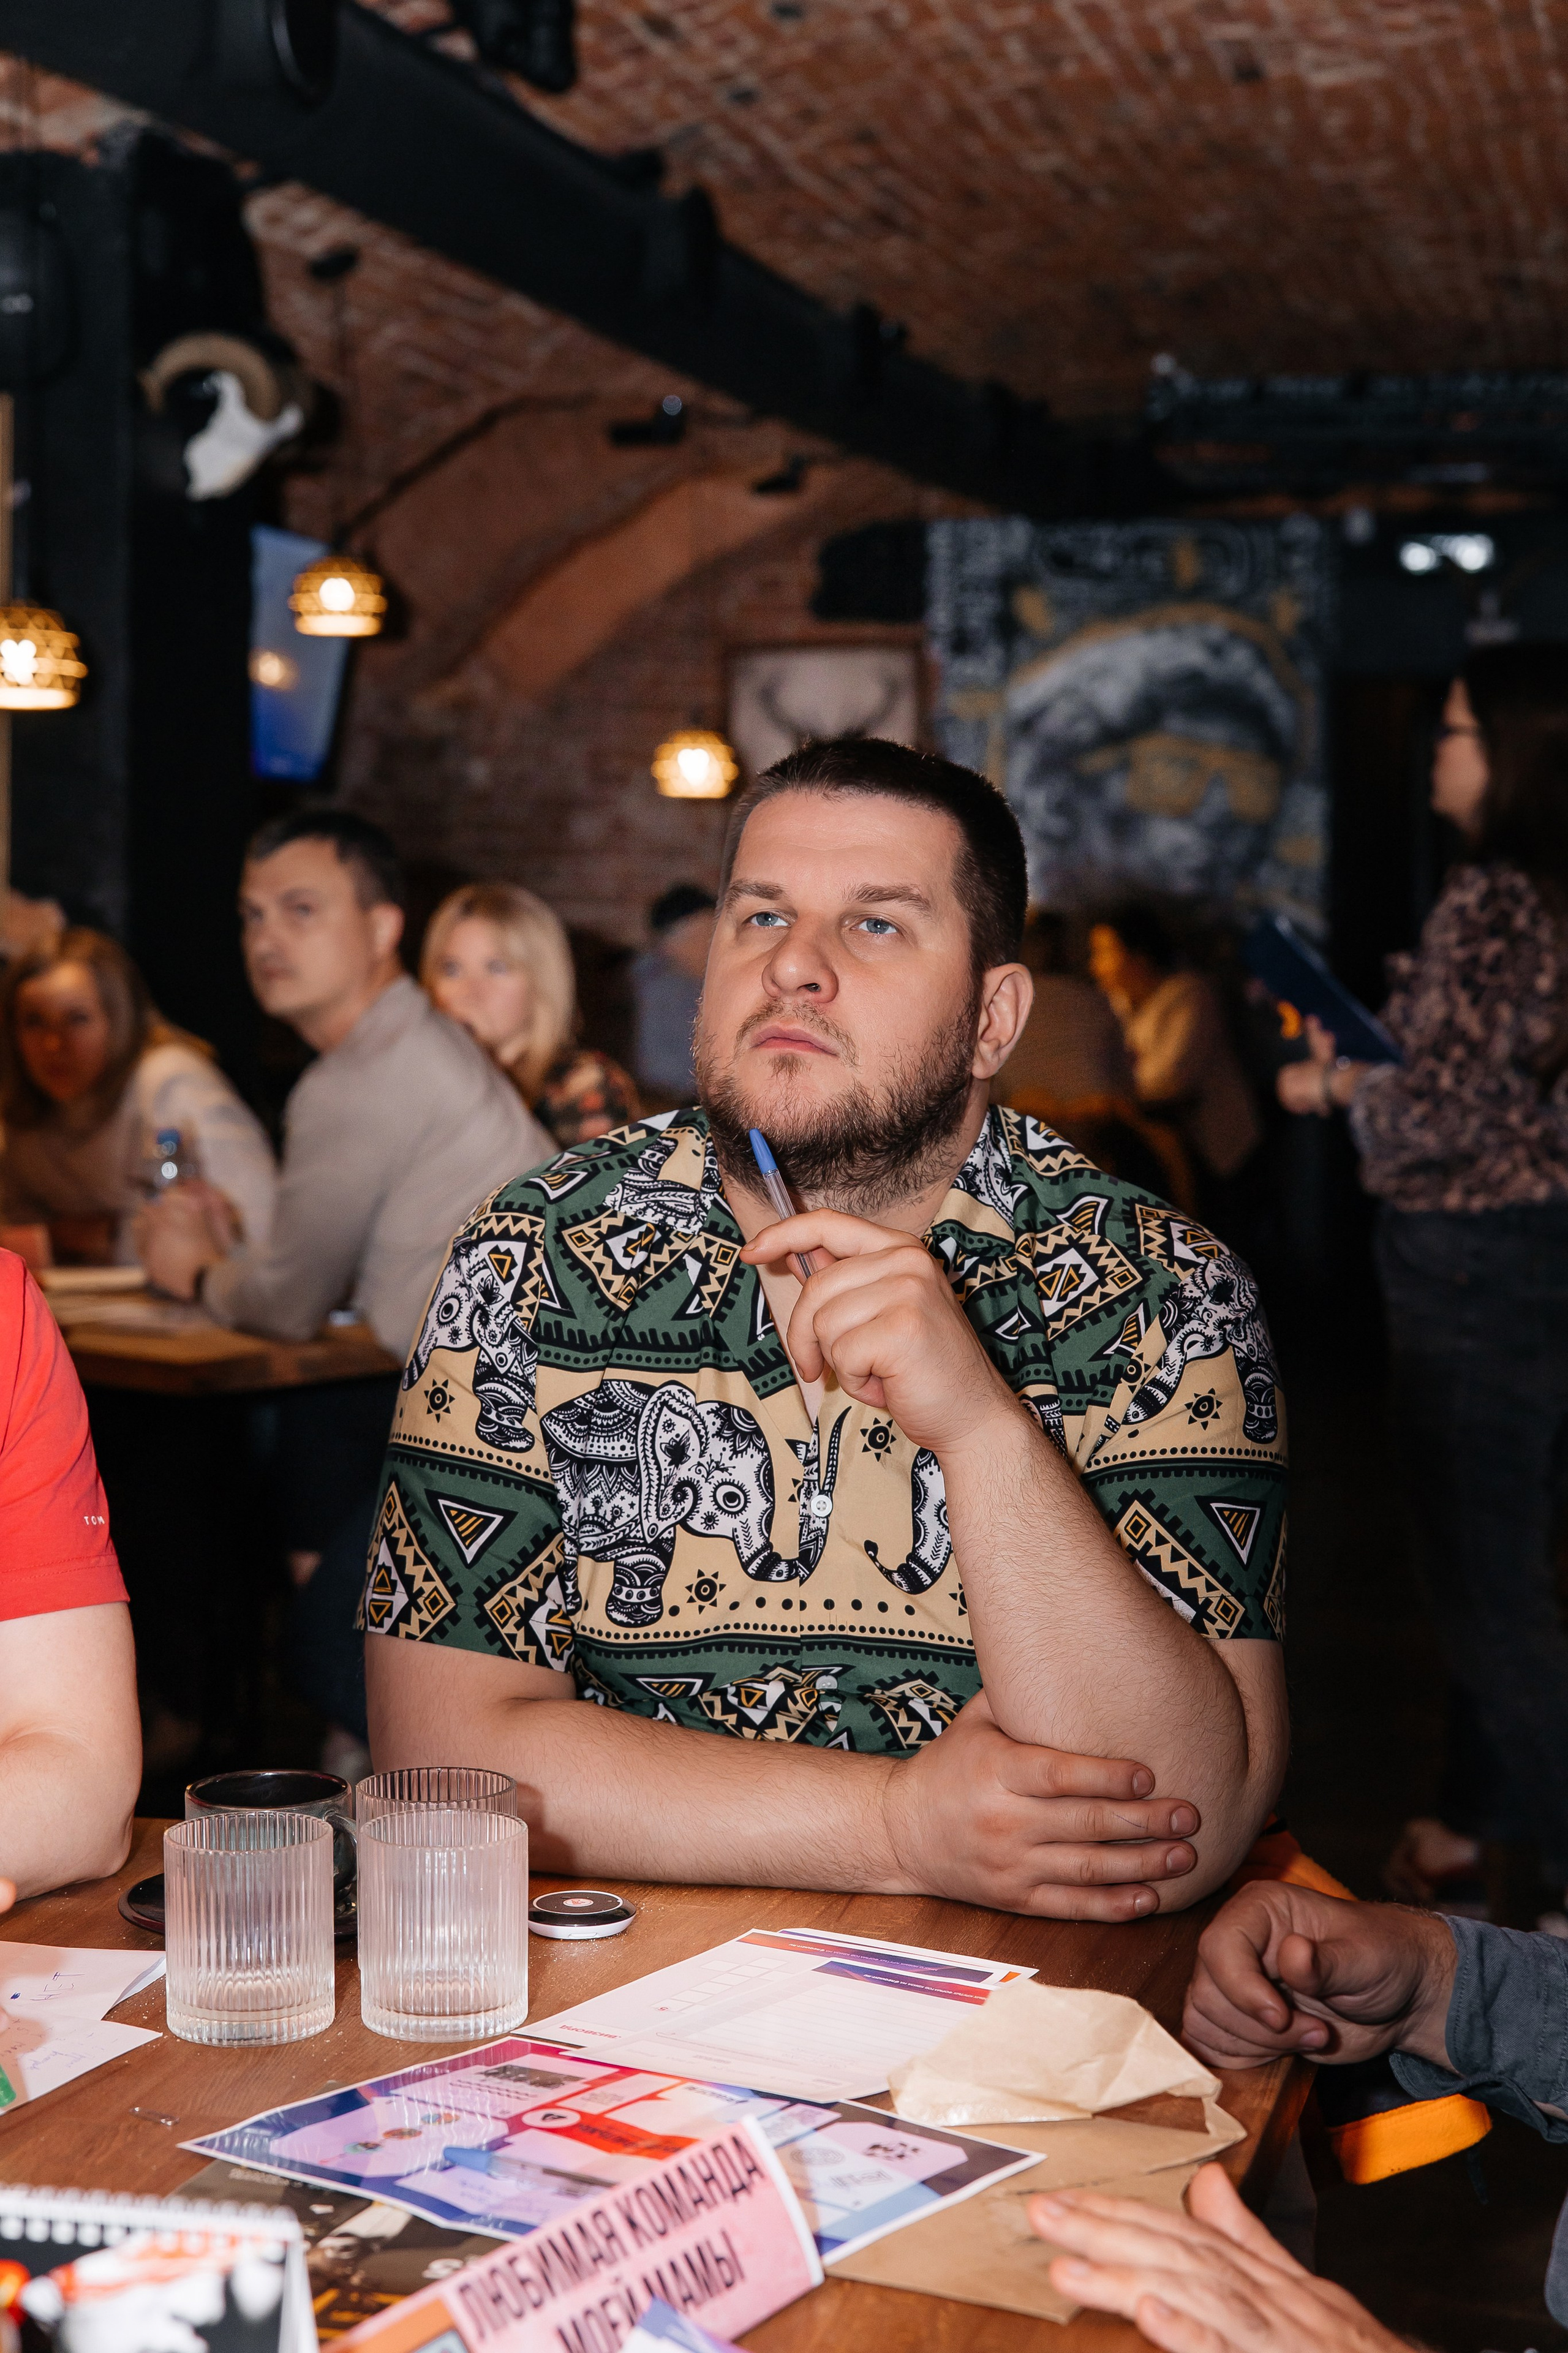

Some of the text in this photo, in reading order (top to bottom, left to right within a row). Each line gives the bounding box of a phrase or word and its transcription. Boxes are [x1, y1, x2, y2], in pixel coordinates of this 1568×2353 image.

[458, 2134, 765, 2341] ЛЮБИМАЯ КОМАНДА
[643, 2229, 745, 2313] МАМЫ
